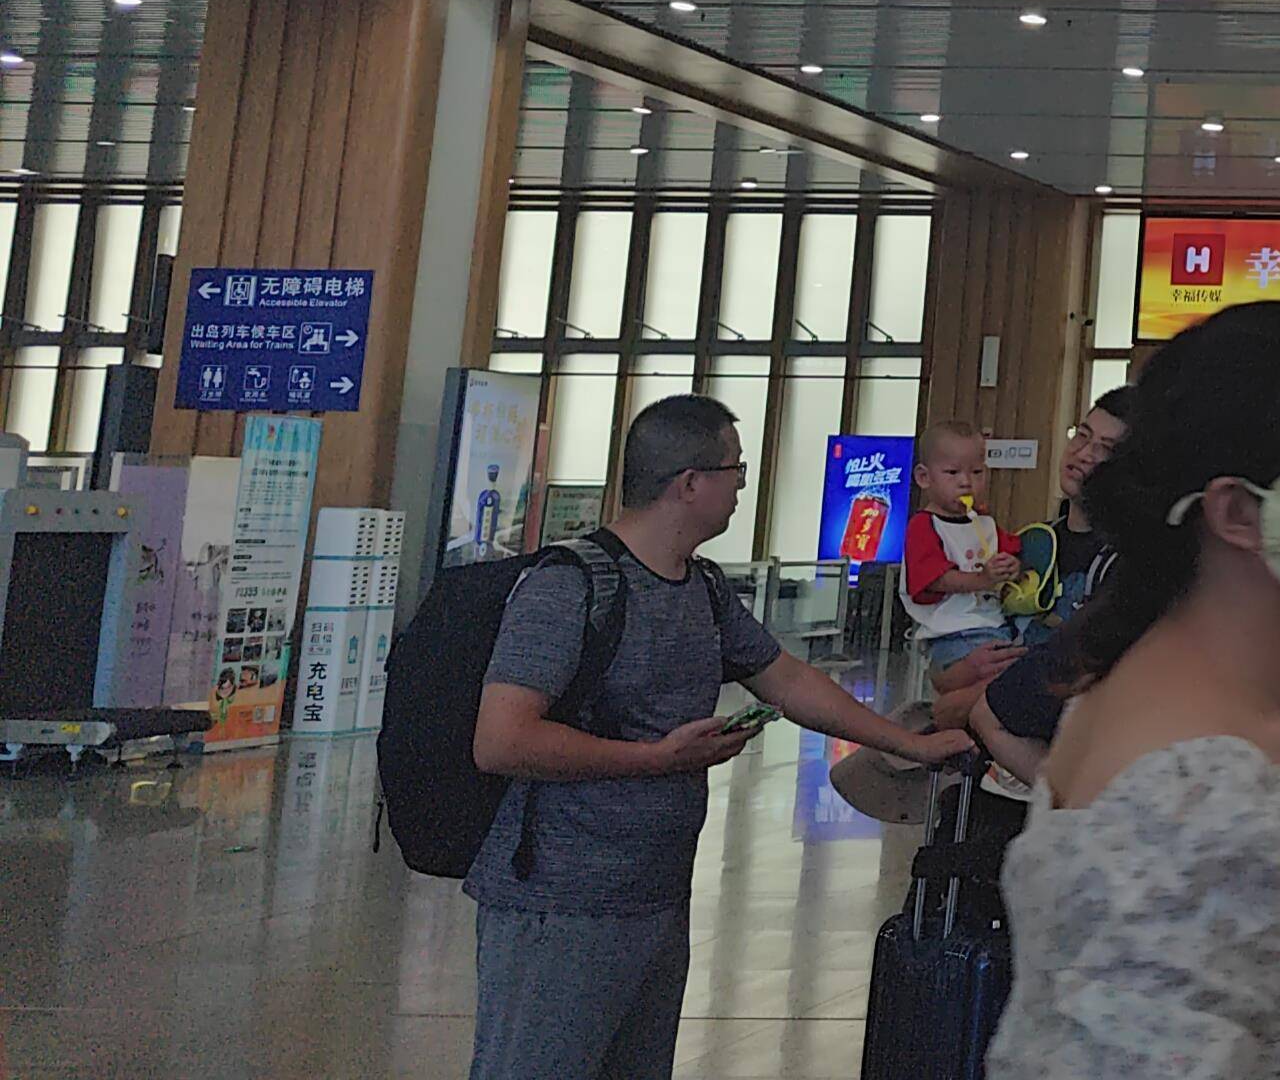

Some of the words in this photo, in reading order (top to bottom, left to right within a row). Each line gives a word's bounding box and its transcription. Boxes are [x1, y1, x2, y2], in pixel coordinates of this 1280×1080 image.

[1186, 247, 1210, 273] H
[261, 277, 364, 297] 无障碍电梯
[1172, 289, 1222, 302] 幸福传媒
[259, 299, 307, 307] Accessible
[191, 324, 296, 339] 出岛列车候车区
[190, 340, 224, 350] Waiting
[226, 340, 247, 349] Area
[250, 340, 263, 349] for
[266, 341, 294, 349] Trains
[845, 453, 885, 474] 怕上火
[302, 662, 327, 722] 充电宝
